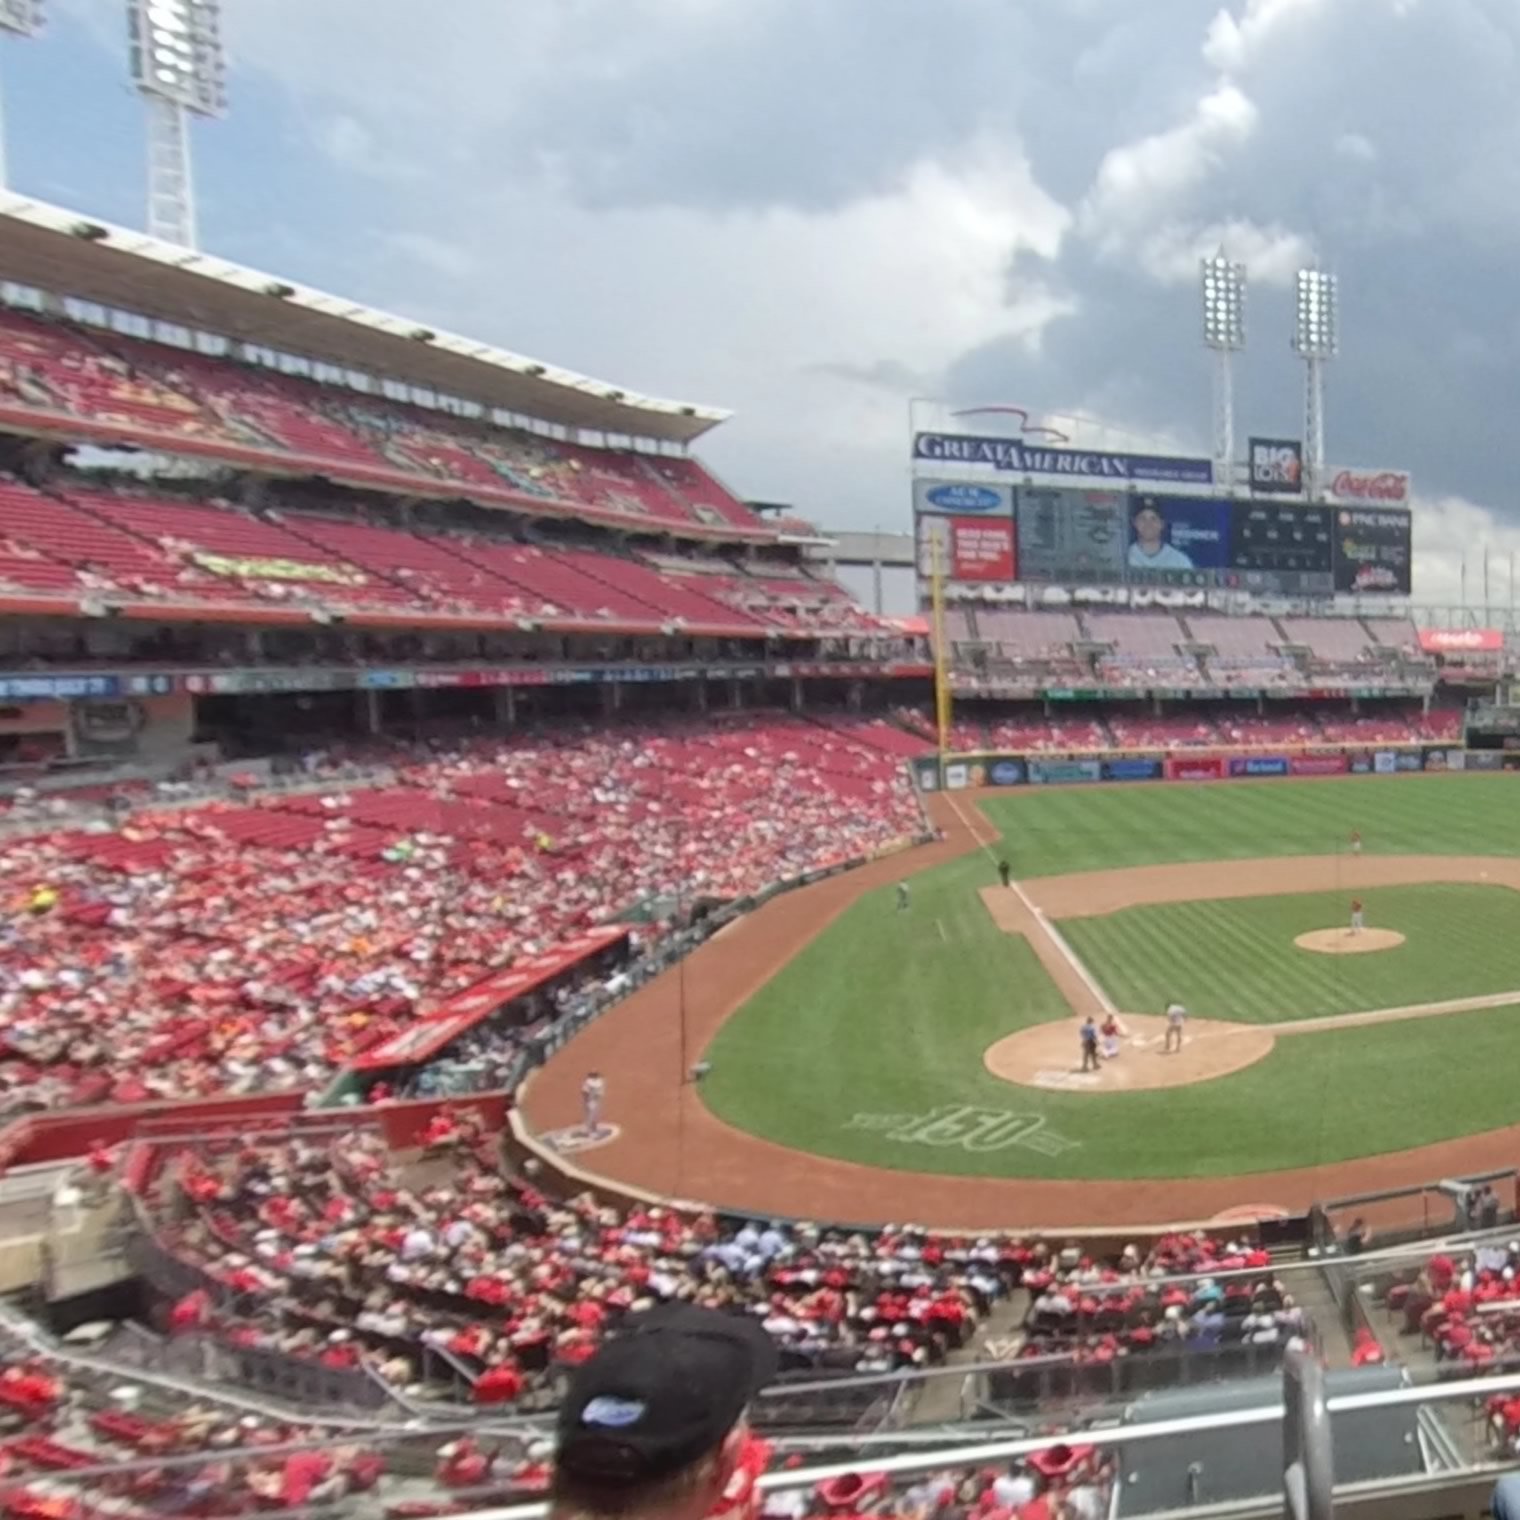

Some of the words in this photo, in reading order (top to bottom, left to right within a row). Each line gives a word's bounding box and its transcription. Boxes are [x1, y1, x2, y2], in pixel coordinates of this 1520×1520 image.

[917, 434, 1005, 460] GREAT
[1253, 446, 1296, 466] BIG
[1001, 447, 1128, 476] AMERICAN
